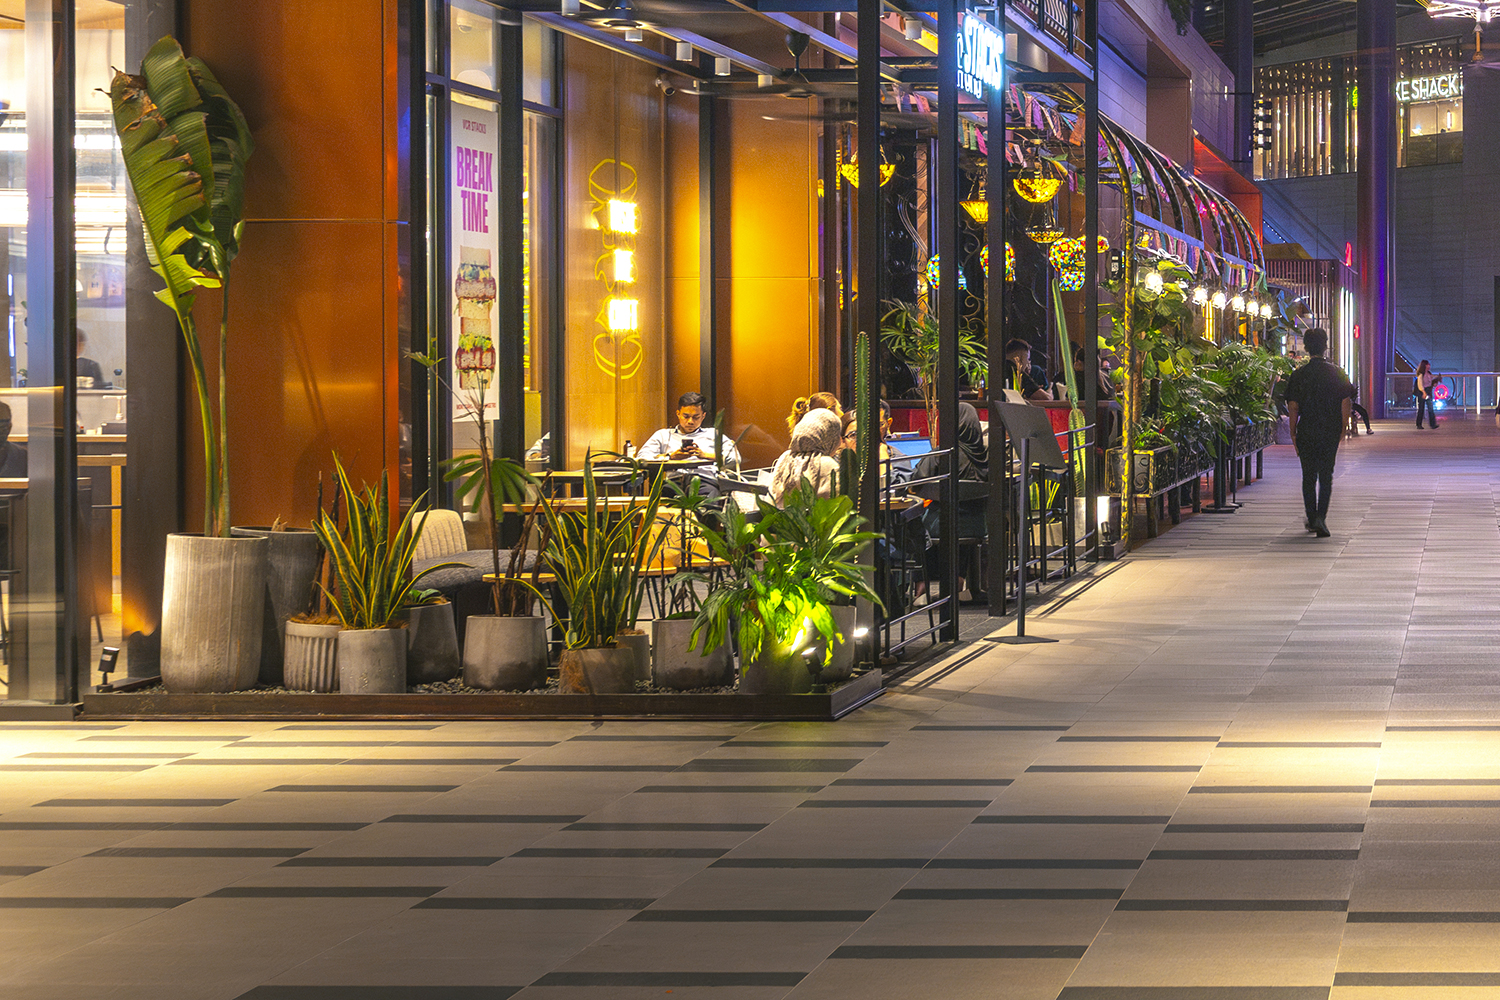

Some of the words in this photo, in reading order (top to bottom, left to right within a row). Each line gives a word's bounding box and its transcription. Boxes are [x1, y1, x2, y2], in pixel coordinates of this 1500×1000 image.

[963, 14, 1004, 91] STACKS
[1411, 74, 1459, 100] SHACK
[456, 145, 493, 193] BREAK
[460, 189, 489, 234] TIME
